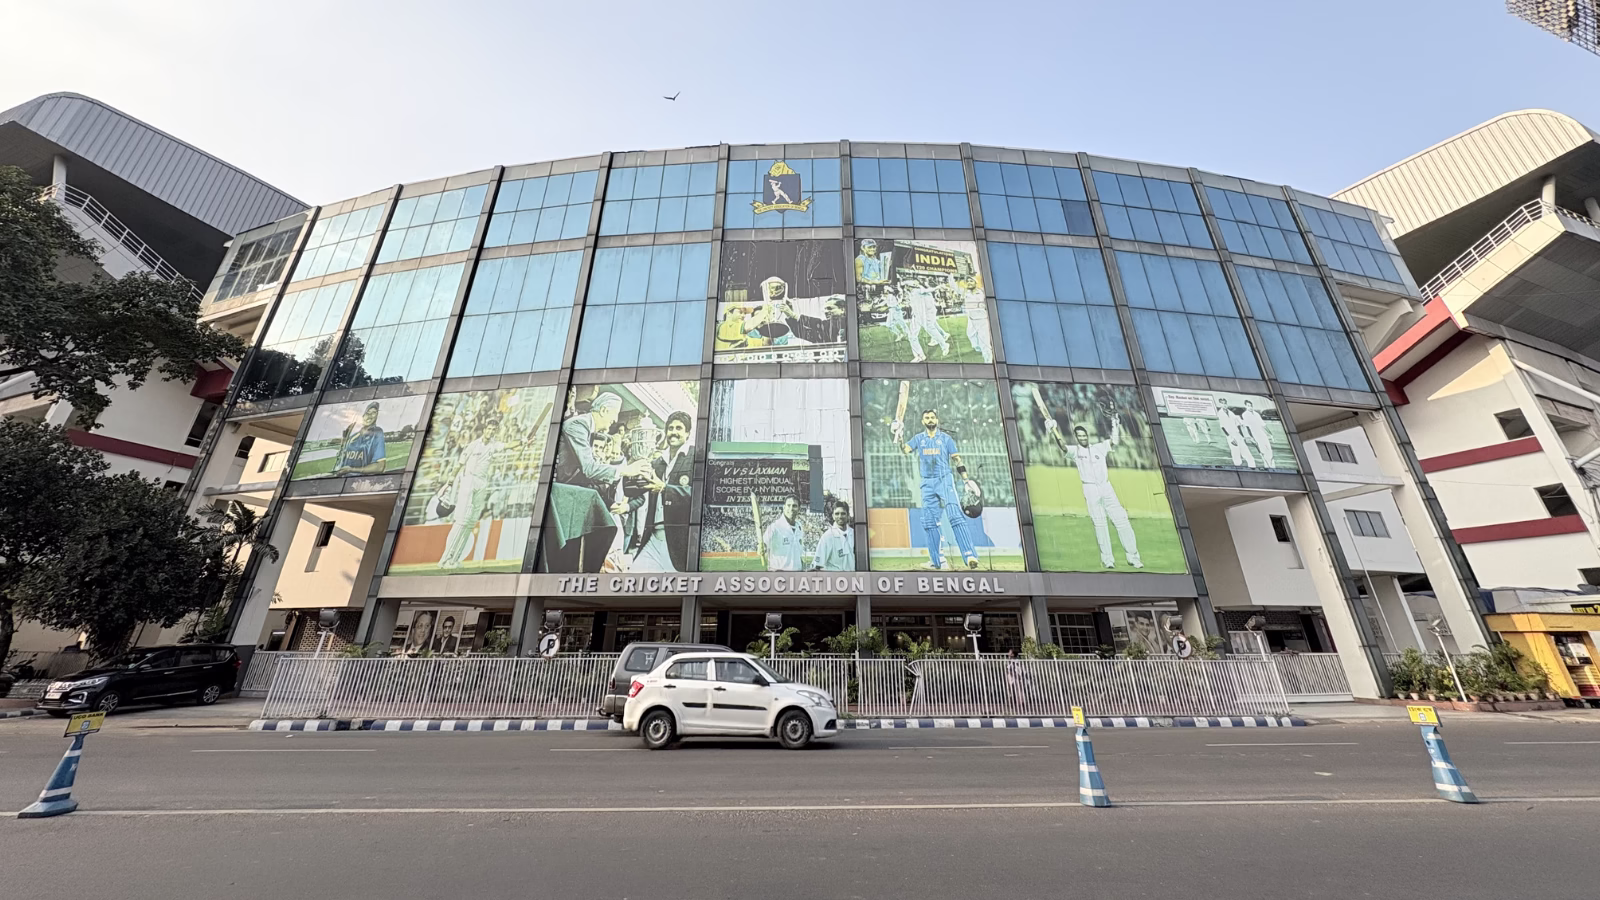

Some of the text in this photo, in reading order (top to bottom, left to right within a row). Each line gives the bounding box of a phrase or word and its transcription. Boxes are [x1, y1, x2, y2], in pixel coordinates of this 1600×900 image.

[915, 253, 956, 267] INDIA
[748, 467, 787, 475] LAXMAN
[719, 477, 794, 485] HIGHEST INDIVIDUAL
[558, 576, 1005, 593] THE CRICKET ASSOCIATION OF BENGAL
